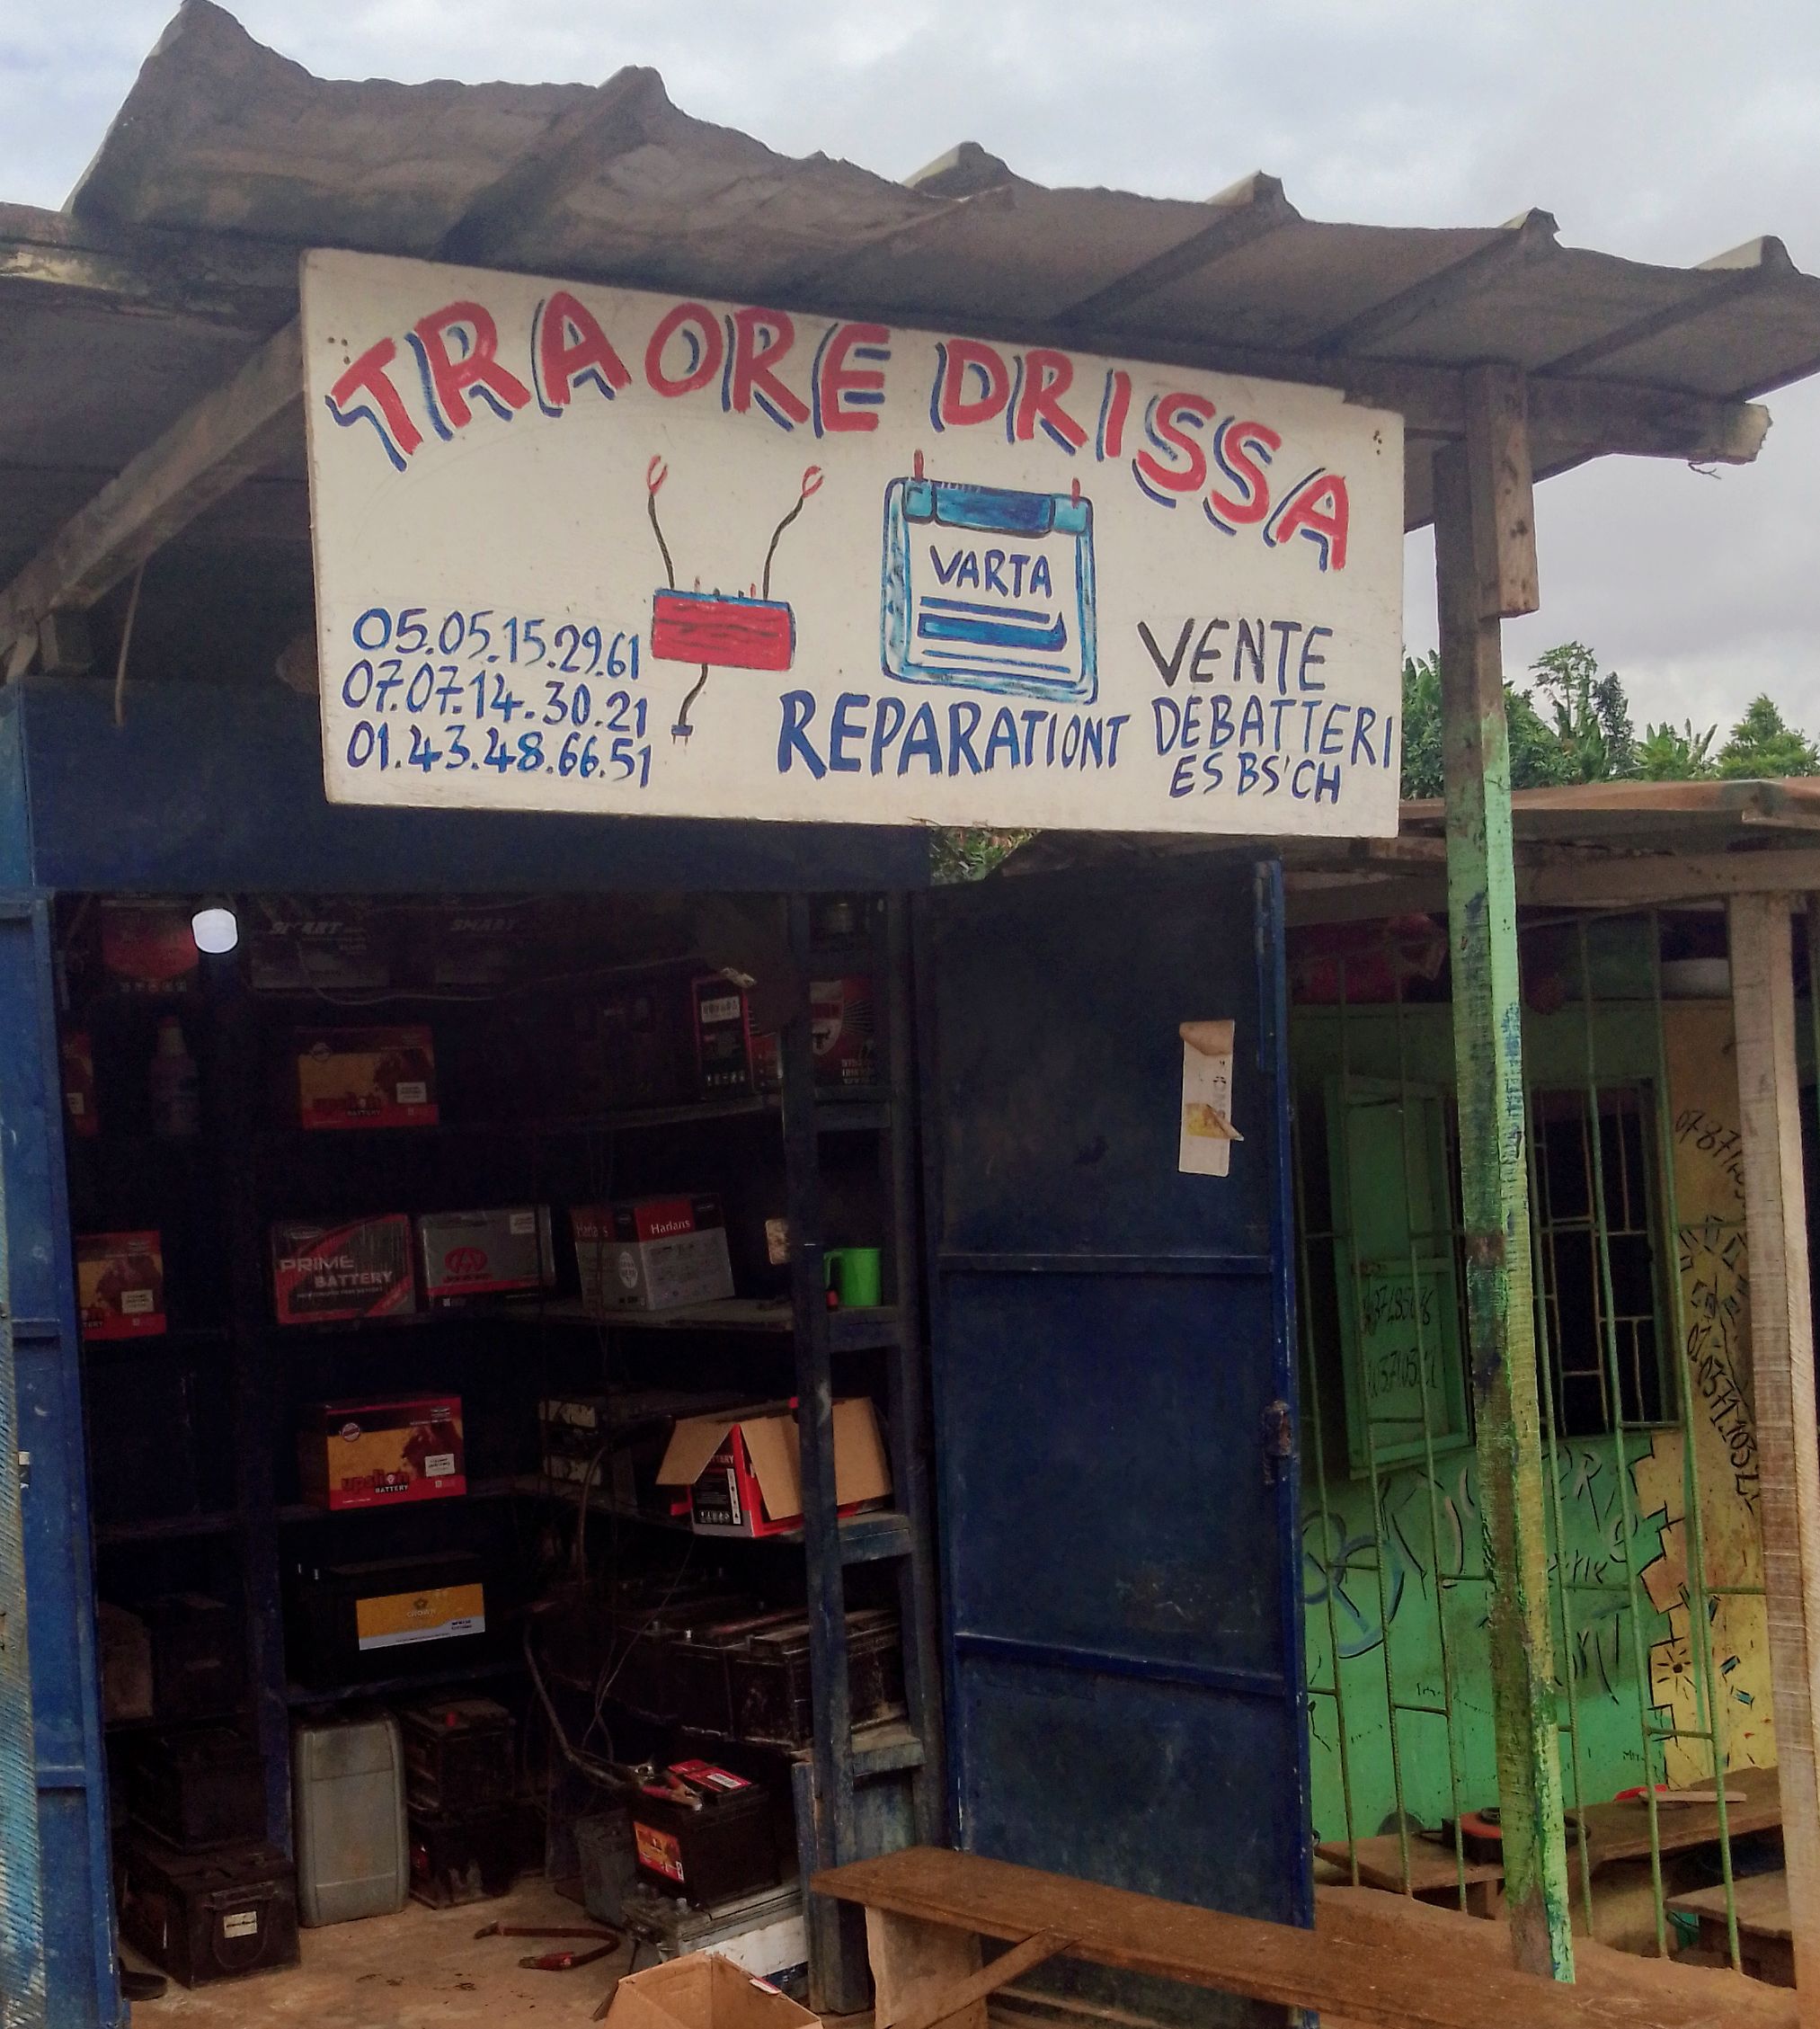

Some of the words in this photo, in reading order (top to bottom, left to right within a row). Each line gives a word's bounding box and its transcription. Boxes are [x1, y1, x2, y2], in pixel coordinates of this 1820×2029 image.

[325, 289, 892, 472] TRAORE
[929, 338, 1351, 573] DRISSA
[928, 545, 1052, 599] VARTA
[352, 607, 641, 681] 05.05.15.29.61
[1138, 617, 1334, 692] VENTE
[342, 659, 649, 738] 07.07.14.30.21
[346, 720, 653, 789] 01.43.48.66.51
[777, 689, 1132, 780] REPARATIONT
[280, 1255, 355, 1274] PRIME
[576, 1220, 609, 1238] Harlas
[315, 1270, 393, 1288] BATTERY
